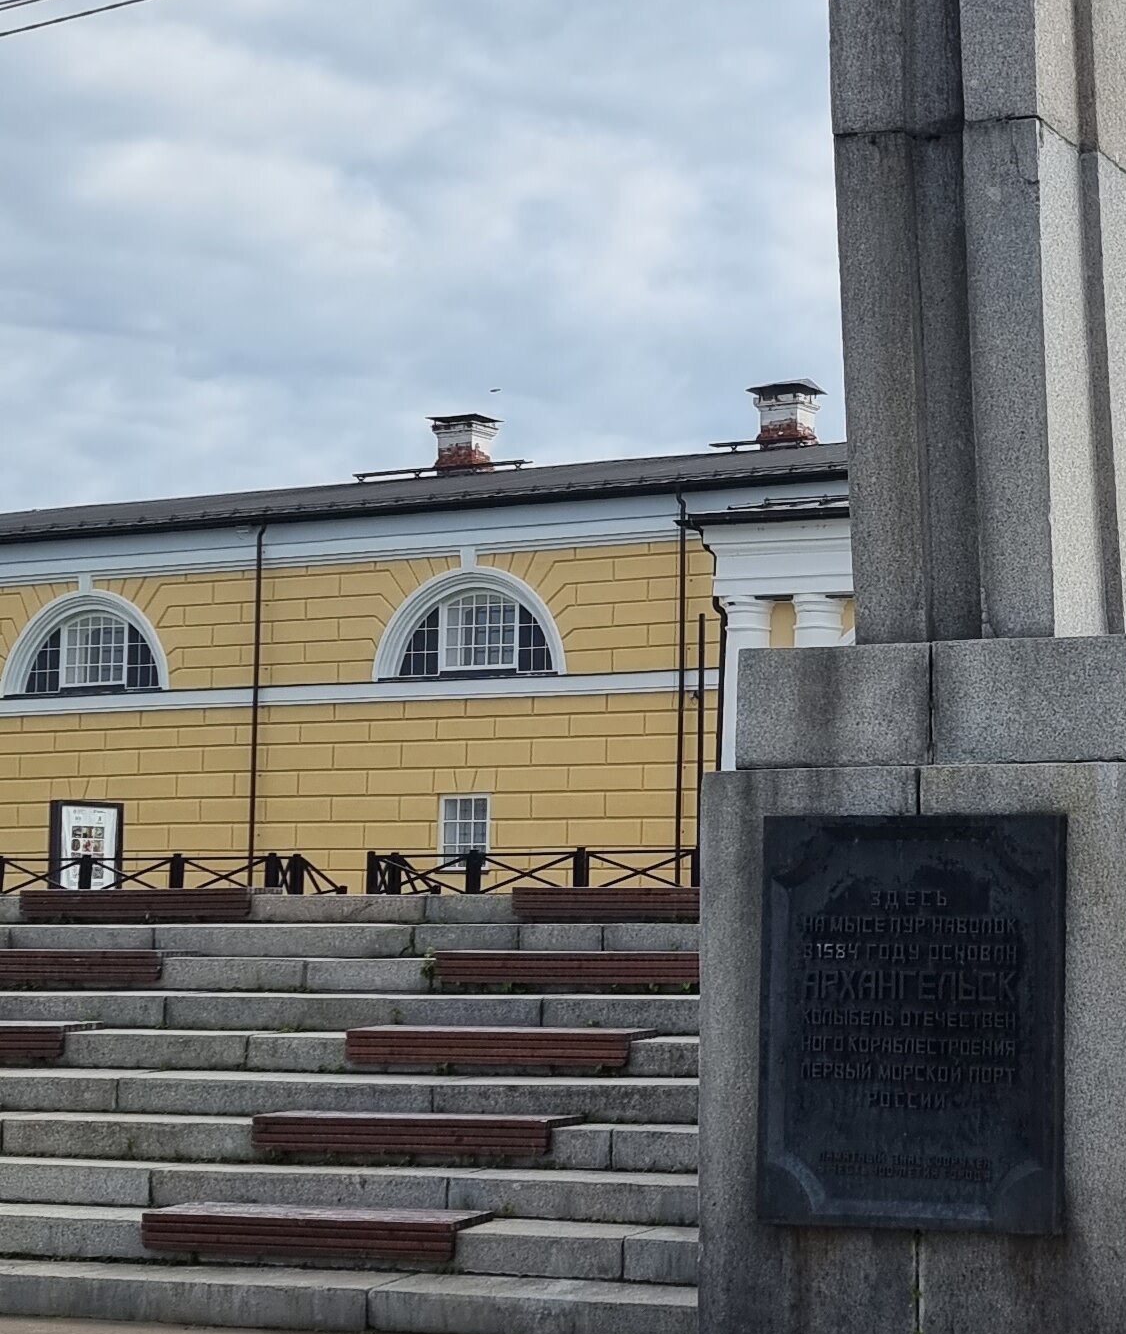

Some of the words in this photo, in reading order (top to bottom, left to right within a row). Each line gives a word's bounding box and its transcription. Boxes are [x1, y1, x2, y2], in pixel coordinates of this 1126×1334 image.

[870, 890, 948, 910] ЗДЕСЬ
[803, 916, 825, 933] НА
[829, 916, 885, 933] МЫСЕ
[803, 943, 812, 959] В
[816, 942, 861, 959] 1584
[866, 944, 920, 963] ГОДУ
[928, 944, 1017, 961] ОСНОВАН
[803, 969, 1017, 1001] АРХАНГЕЛЬСК
[802, 1009, 894, 1026] КОЛЫБЕЛЬ
[900, 1010, 1016, 1028] ОТЕЧЕСТВЕН
[801, 1035, 844, 1052] НОГО
[848, 1036, 1016, 1056] КОРАБЛЕСТРОЕНИЯ
[800, 1058, 872, 1079] ПЕРВЫЙ
[877, 1060, 961, 1083] МОРСКОЙ
[969, 1065, 1016, 1085] ПОРТ
[867, 1090, 946, 1109] РОССИИ
